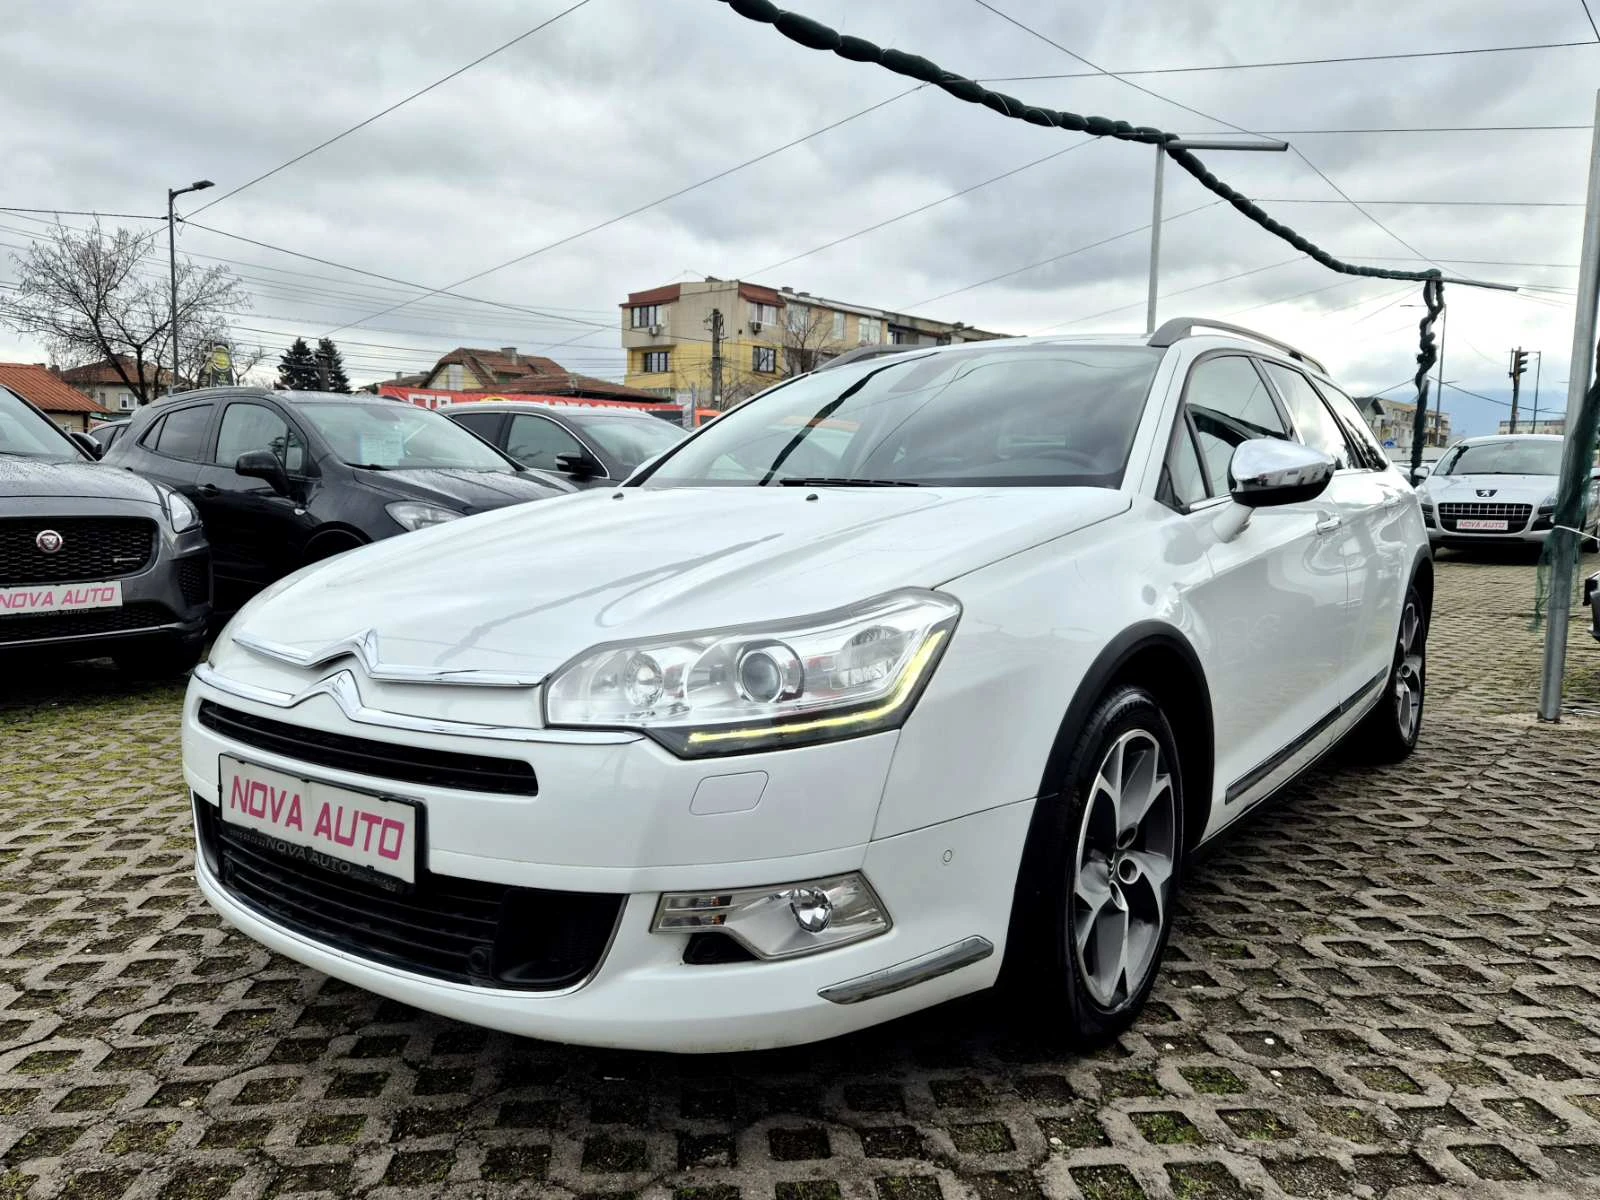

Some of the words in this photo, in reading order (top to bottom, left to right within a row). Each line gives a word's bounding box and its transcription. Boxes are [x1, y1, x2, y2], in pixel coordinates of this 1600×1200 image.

[0, 591, 53, 608] NOVA
[62, 587, 114, 605] AUTO
[230, 775, 303, 832] NOVA
[313, 802, 405, 860] AUTO
[267, 838, 307, 860] NOVA
[309, 851, 351, 873] AUTO
